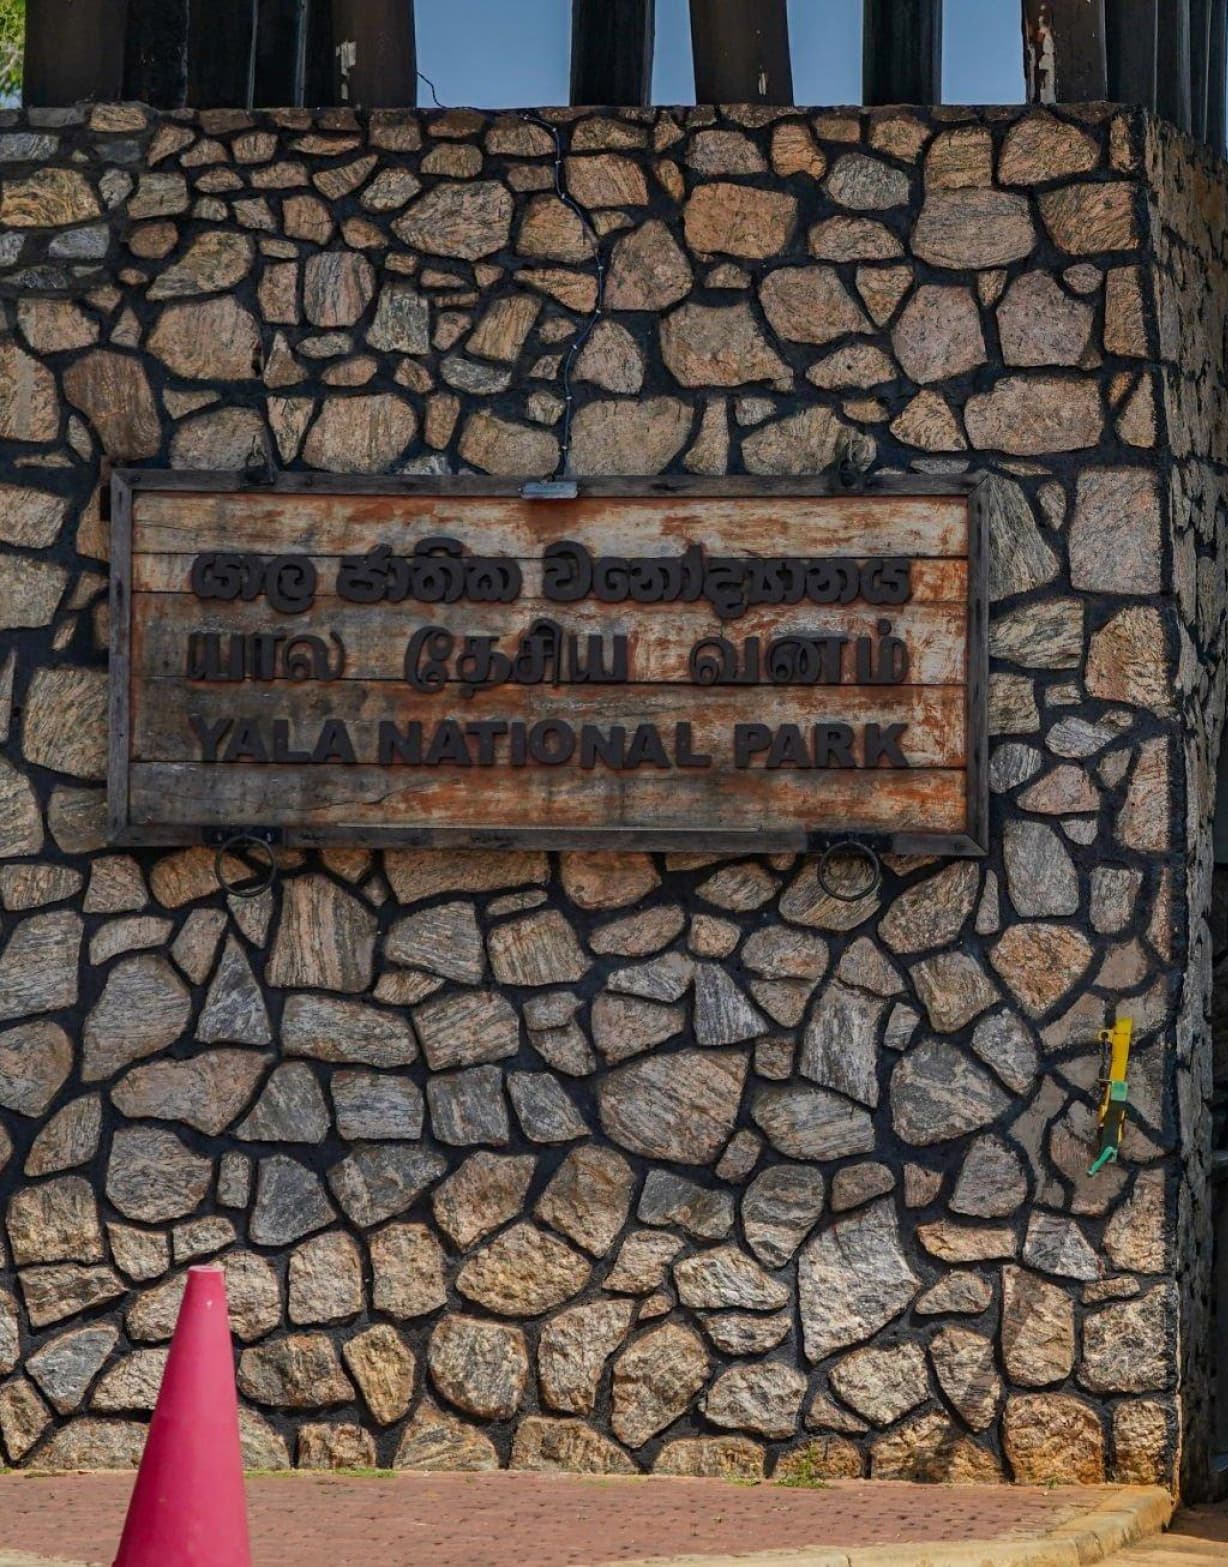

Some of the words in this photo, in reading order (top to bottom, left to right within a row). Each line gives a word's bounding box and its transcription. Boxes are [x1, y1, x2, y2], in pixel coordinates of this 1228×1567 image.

[187, 631, 346, 683] யால
[404, 618, 628, 698] தேசிய
[689, 618, 909, 685] வனம்
[188, 718, 357, 764] YALA
[378, 719, 712, 769] NATIONAL
[734, 722, 910, 769] PARK
